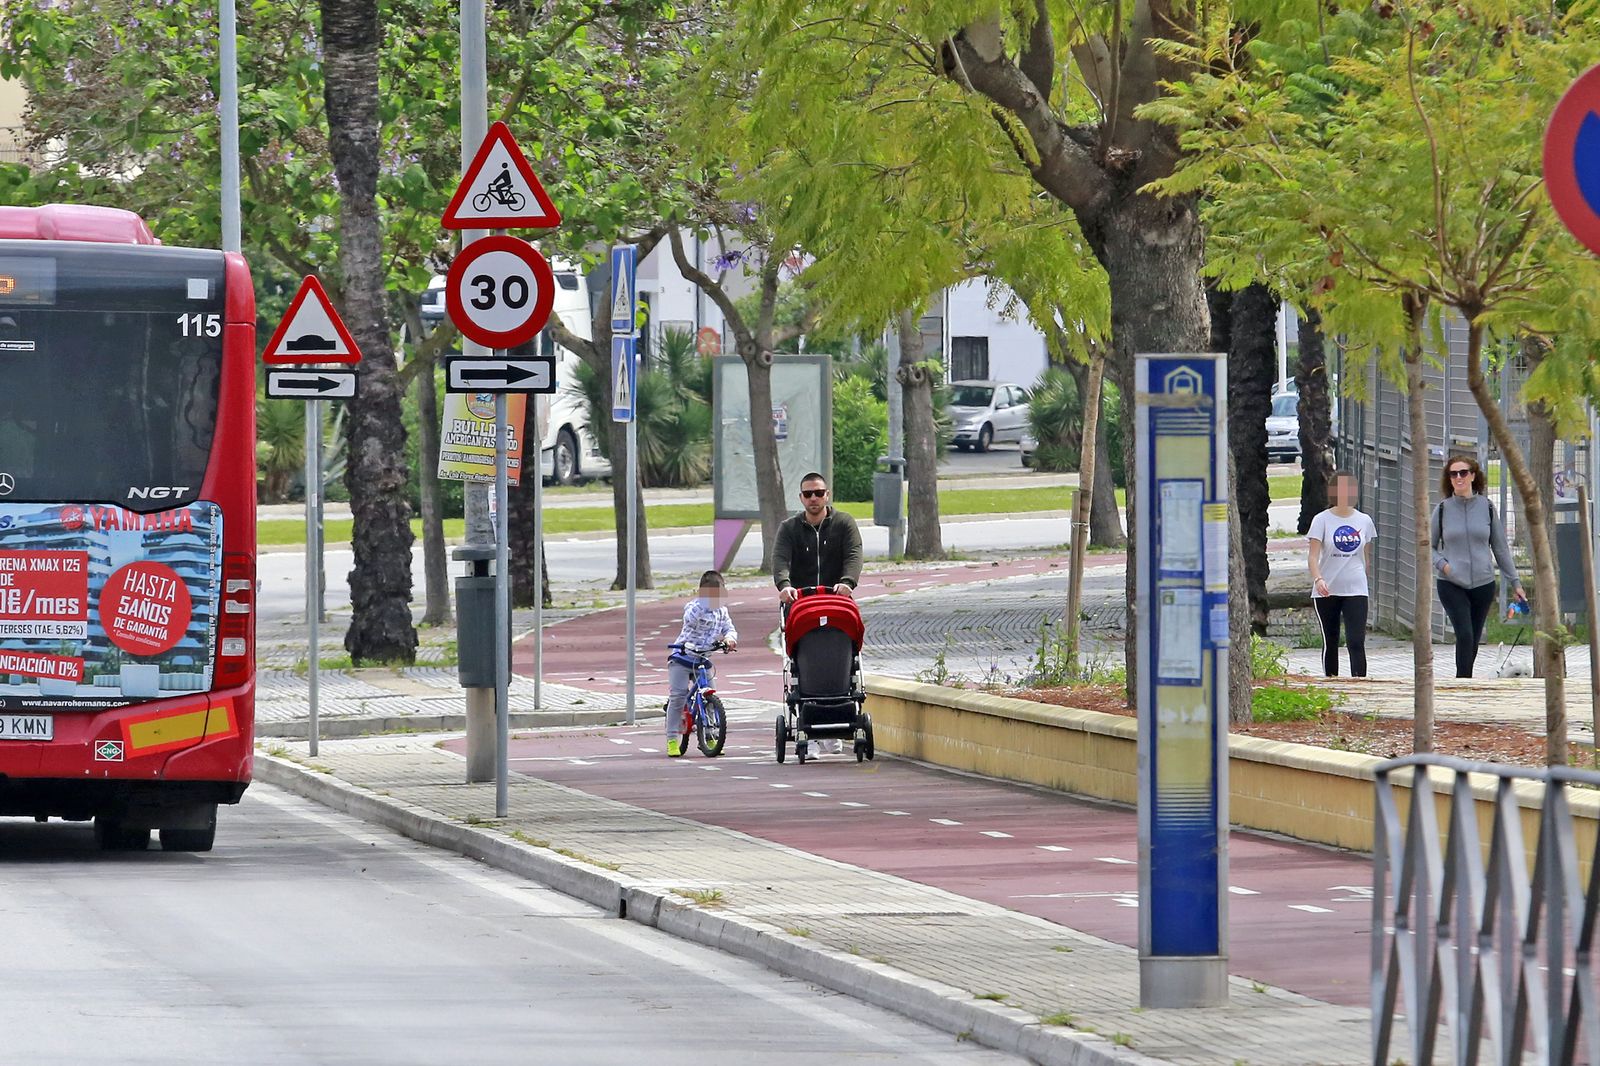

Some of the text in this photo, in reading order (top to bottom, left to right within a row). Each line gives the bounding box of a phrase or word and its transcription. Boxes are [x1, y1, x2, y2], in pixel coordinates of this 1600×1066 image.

[470, 274, 529, 311] 30
[176, 313, 222, 337] 115
[453, 419, 515, 440] BULLDG
[445, 432, 481, 447] AMERICAN
[482, 437, 497, 448] FAS
[127, 486, 190, 499] NGT
[90, 506, 193, 531] YAMAHA
[1335, 535, 1360, 543] NASA
[30, 558, 59, 572] XMAX
[63, 558, 80, 572] 125
[0, 573, 14, 586] DE
[123, 569, 177, 603] HASTA
[0, 624, 32, 634] TERESES
[113, 617, 168, 641] DE GARANTÍA
[0, 655, 78, 677] NCIACIÓN 0%
[12, 718, 47, 735] KMN
[101, 747, 118, 755] CNG
